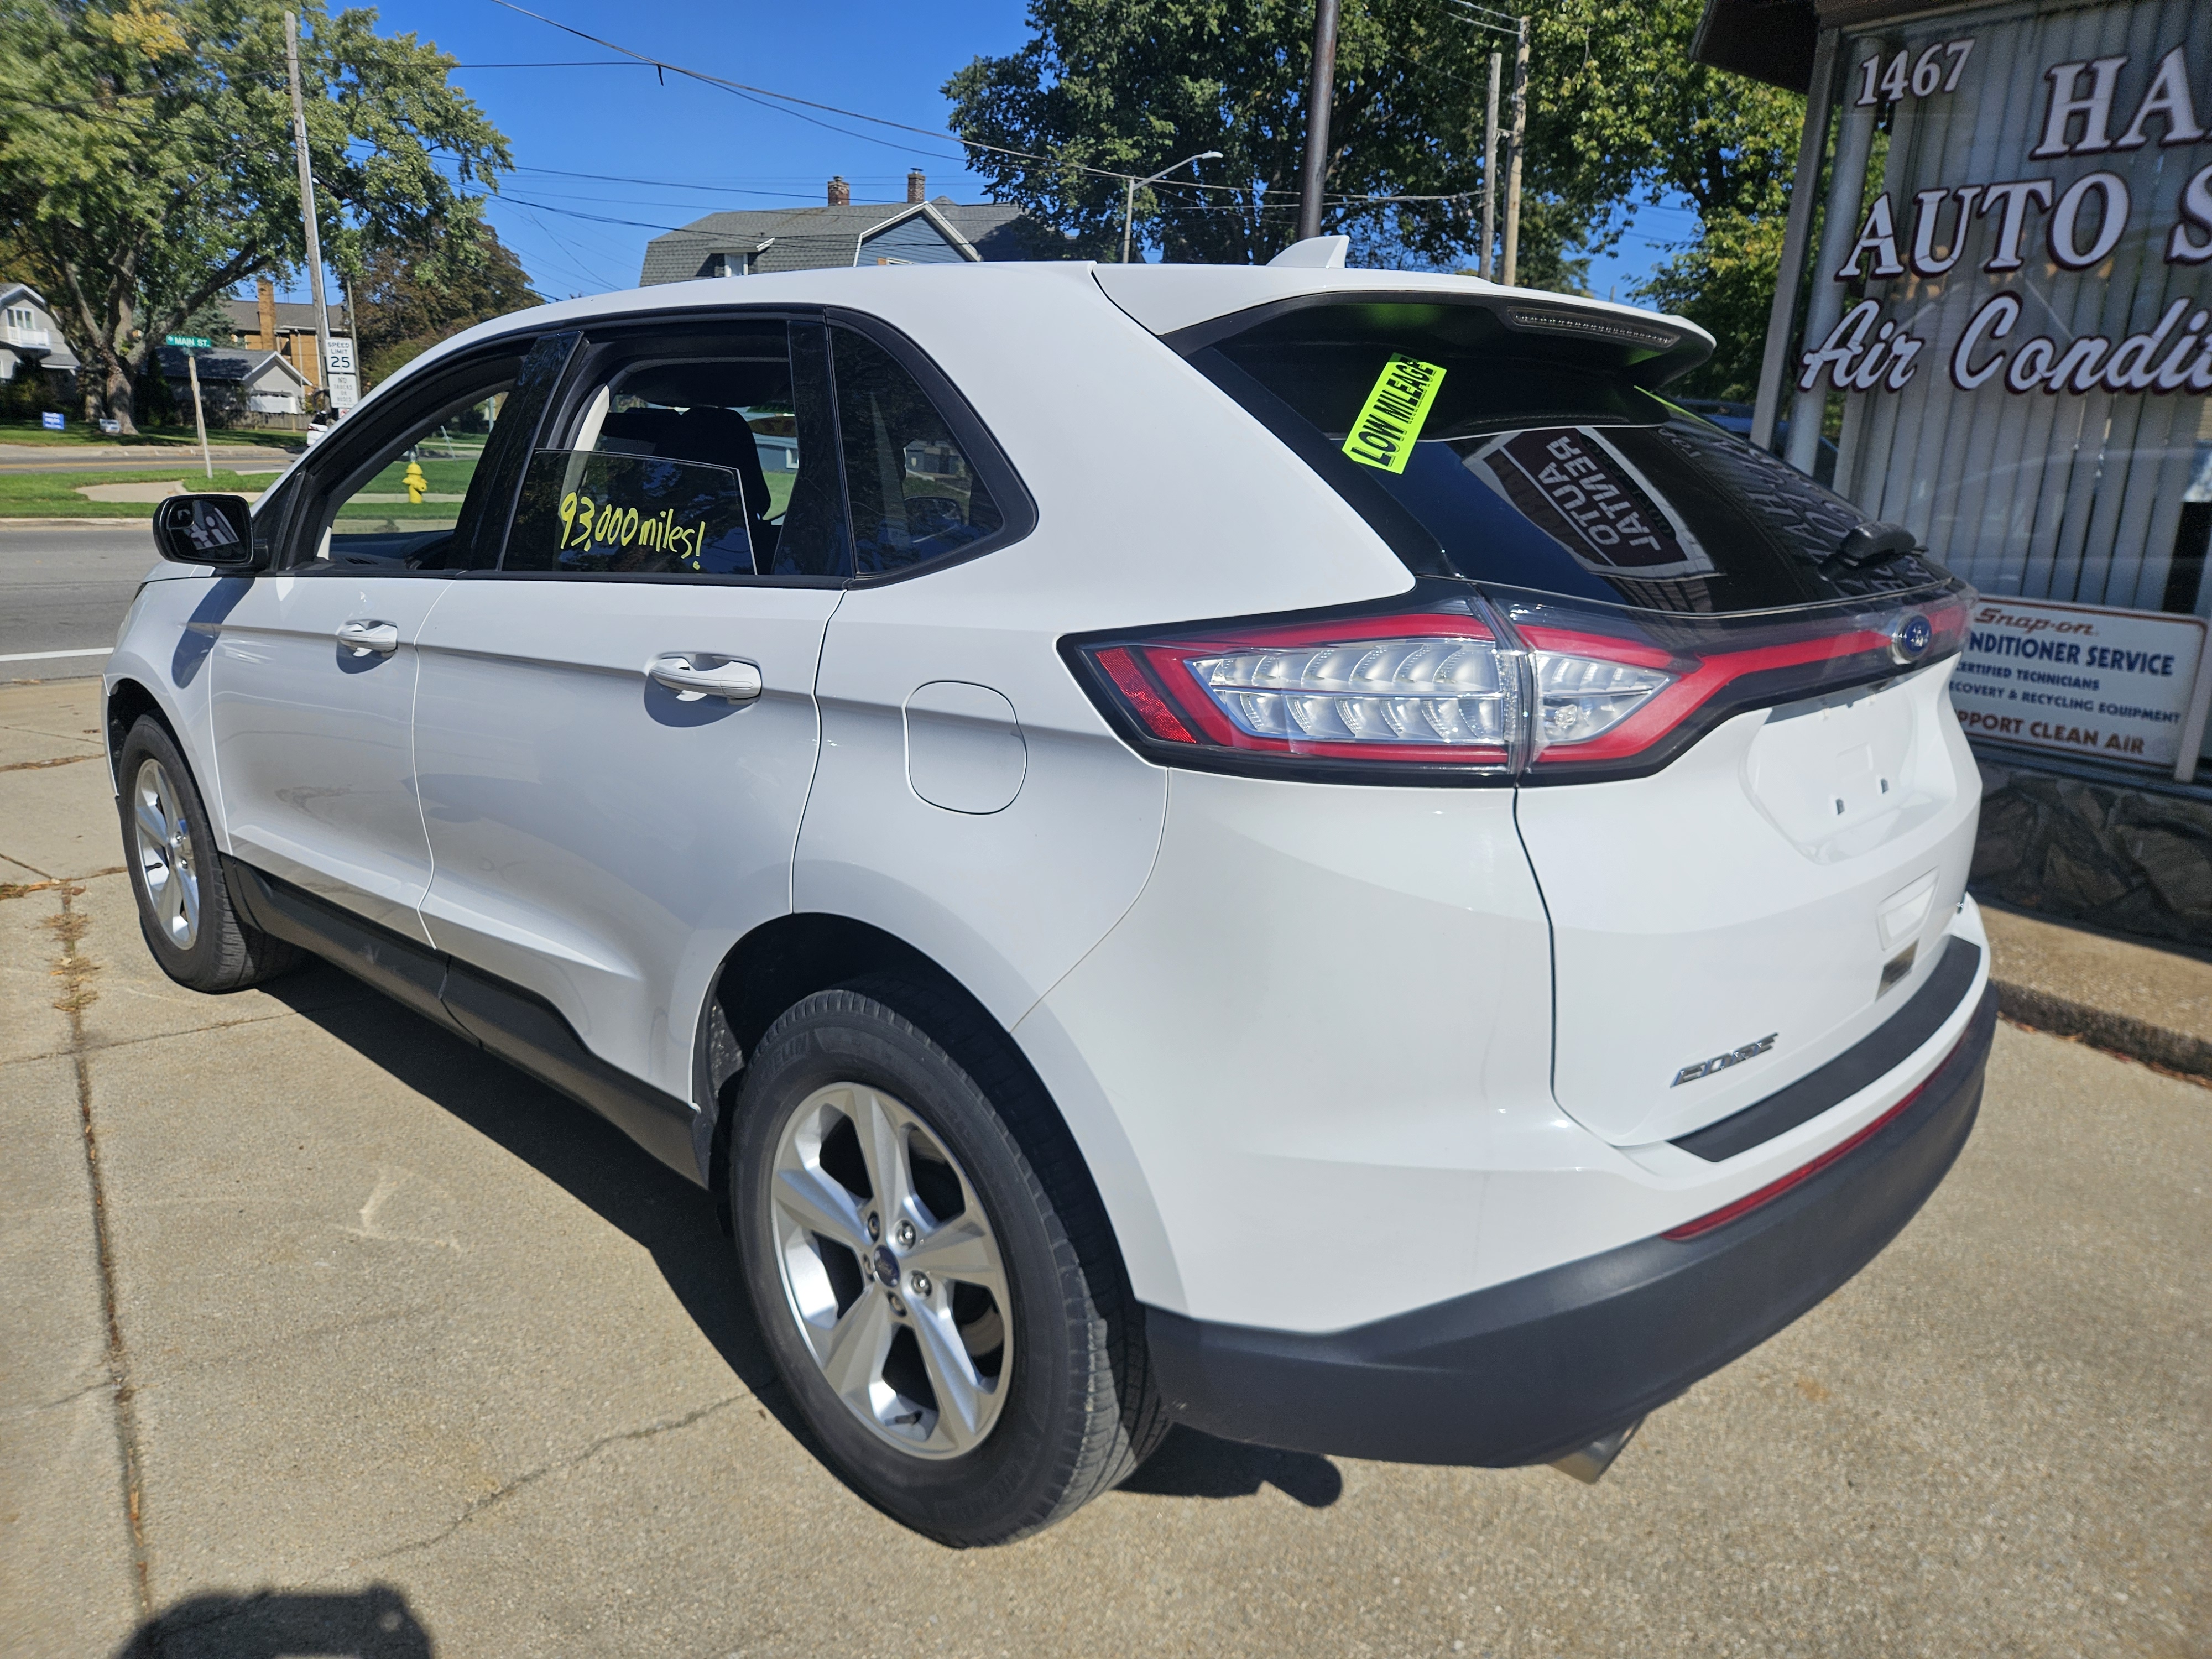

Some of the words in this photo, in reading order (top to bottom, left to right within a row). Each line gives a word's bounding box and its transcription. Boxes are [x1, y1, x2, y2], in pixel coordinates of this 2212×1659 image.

[1855, 38, 1976, 107] 1467
[2030, 43, 2212, 161] HA
[1834, 171, 2131, 281] AUTO
[174, 337, 195, 346] MAIN
[197, 338, 210, 347] ST.
[330, 356, 351, 368] 25
[1797, 297, 1925, 394] Air
[1372, 356, 1437, 425] MILEAGE
[1350, 413, 1407, 467] LOW
[560, 492, 638, 552] 93,000
[638, 508, 706, 570] miles!
[1974, 607, 2095, 635] Snap-on
[1969, 631, 2081, 665] NDITIONER
[2085, 645, 2175, 676] SERVICE
[2016, 668, 2100, 691] TECHNICIANS
[1955, 708, 2025, 734] PPORT
[2029, 721, 2099, 746] CLEAN
[2104, 732, 2145, 755] AIR
[2008, 688, 2018, 701] &
[2021, 690, 2094, 712] RECYCLING
[2098, 701, 2182, 725] EQUIPMENT
